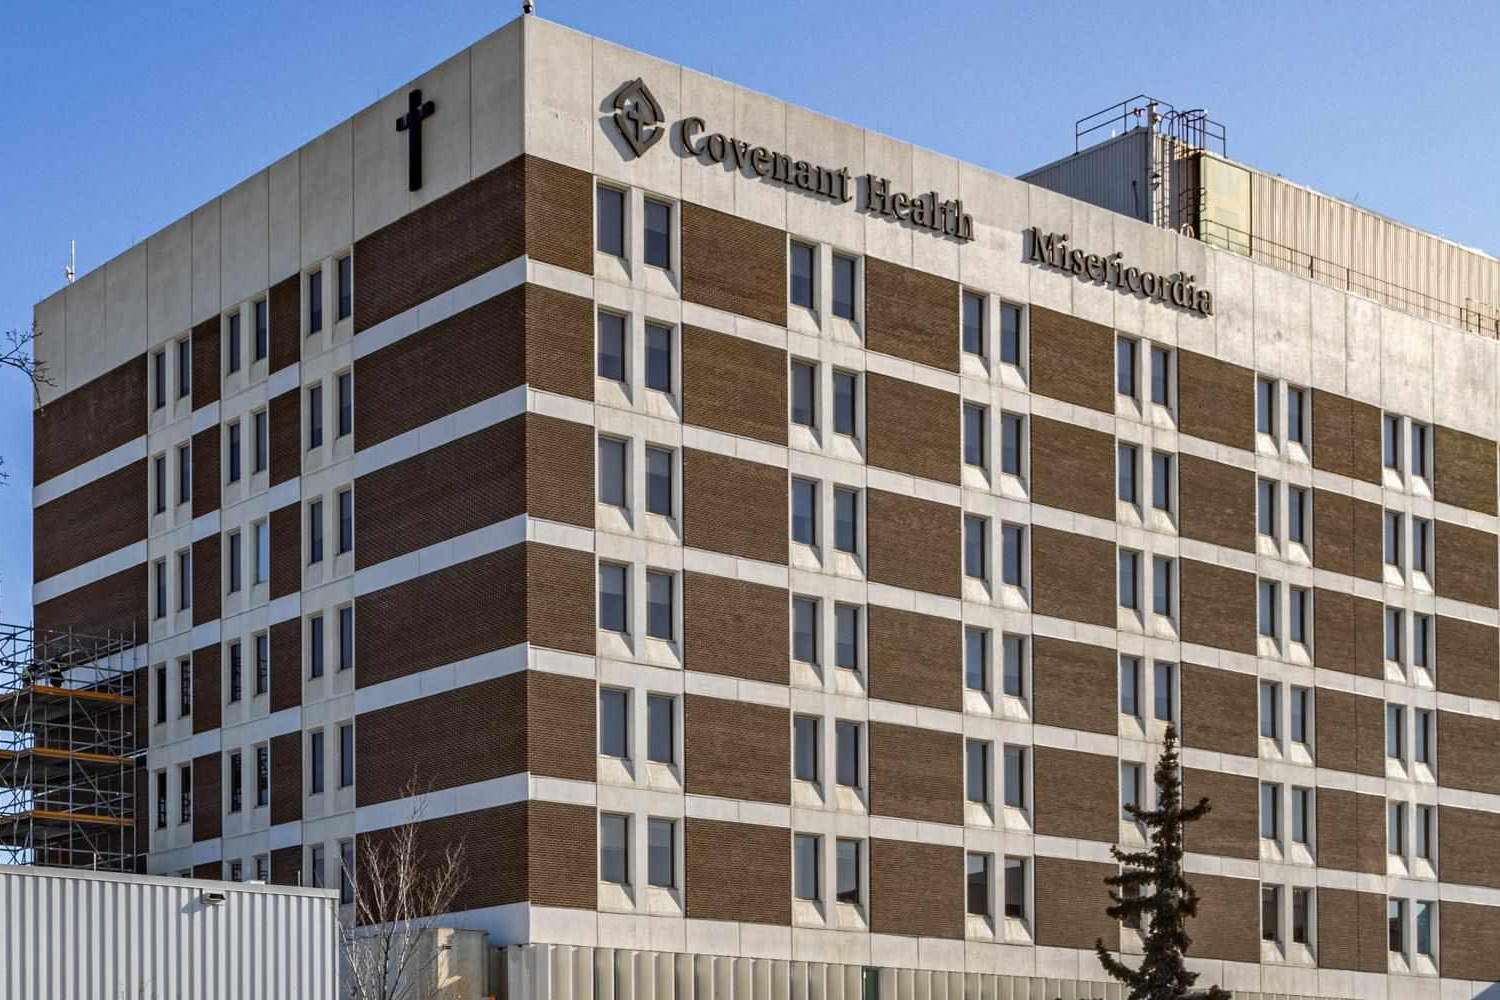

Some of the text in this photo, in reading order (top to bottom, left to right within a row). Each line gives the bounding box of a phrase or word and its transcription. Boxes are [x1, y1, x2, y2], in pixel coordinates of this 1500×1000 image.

[681, 116, 975, 242] Covenant Health
[1029, 226, 1215, 316] Misericordia
